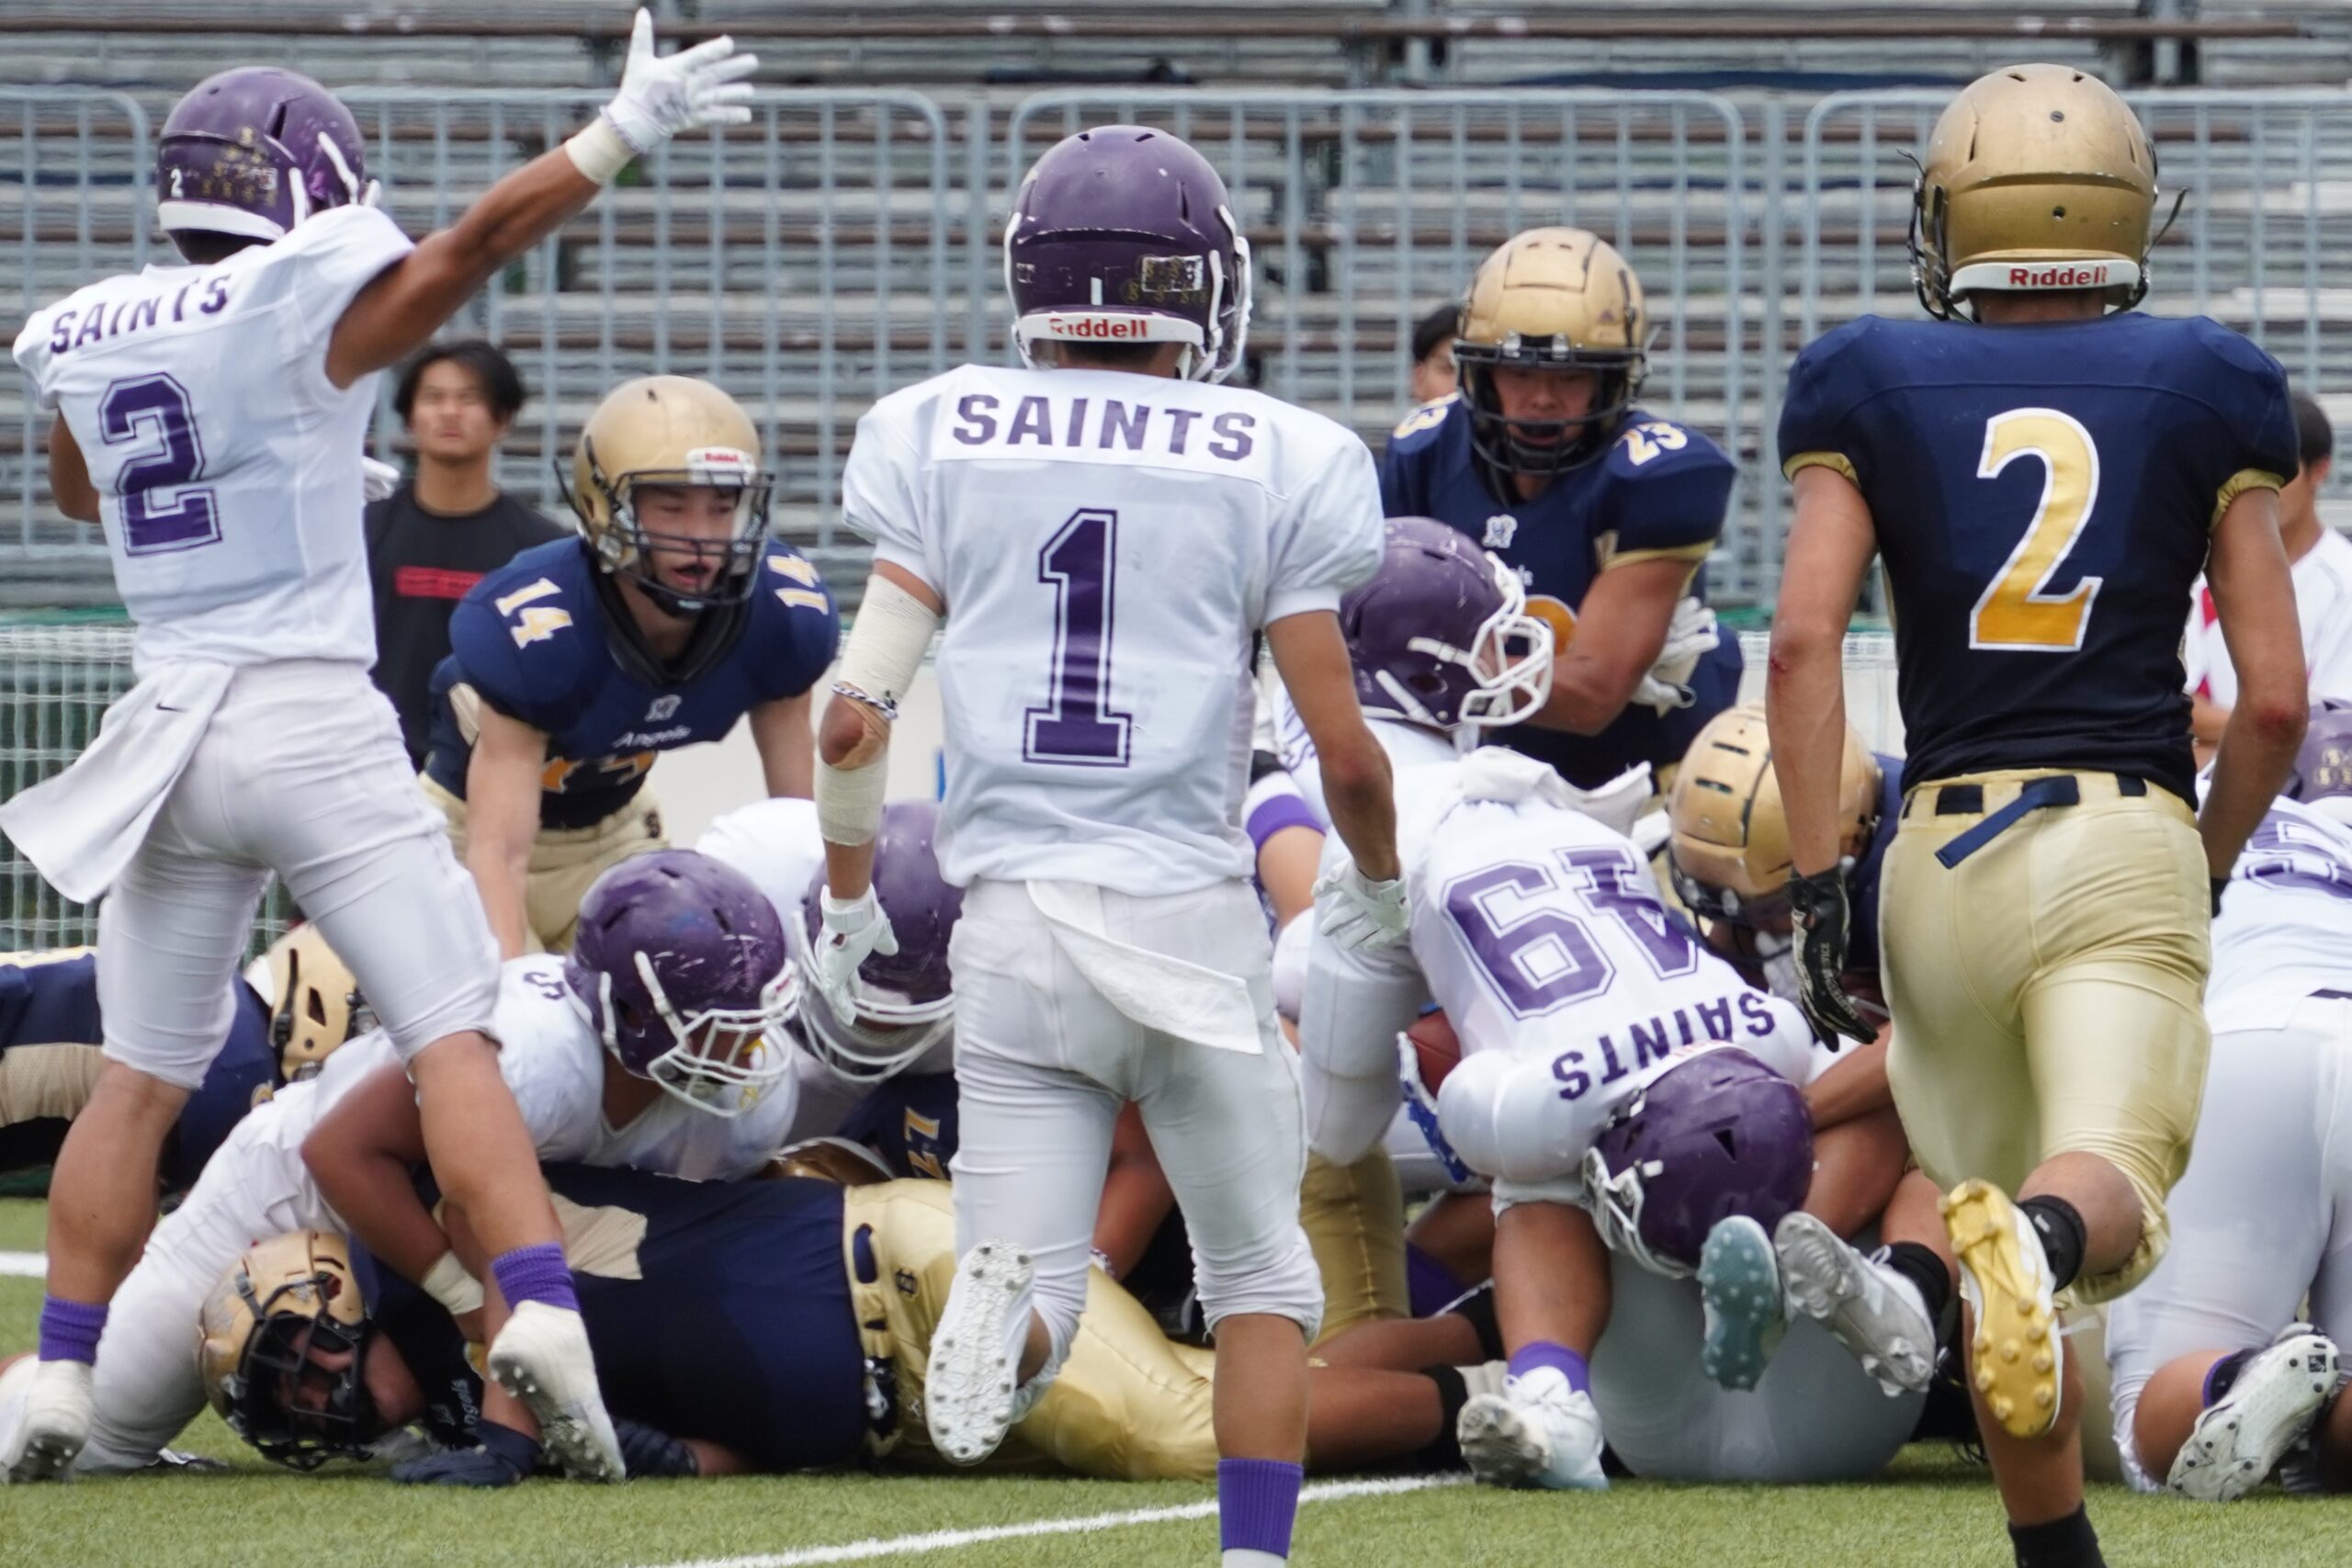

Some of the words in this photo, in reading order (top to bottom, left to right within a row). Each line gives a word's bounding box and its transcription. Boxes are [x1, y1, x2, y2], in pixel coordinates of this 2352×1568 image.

[170, 168, 184, 199] 2
[50, 274, 232, 354] SAINTS
[2009, 265, 2108, 287] Riddell
[97, 372, 223, 558] 2
[953, 394, 1256, 461] SAINTS
[1612, 423, 1688, 466] 23
[1969, 407, 2104, 652] 2
[494, 577, 573, 650] 14
[1023, 507, 1133, 768] 1
[1440, 844, 1698, 1021] 49
[1552, 992, 1775, 1100] SAINTS
